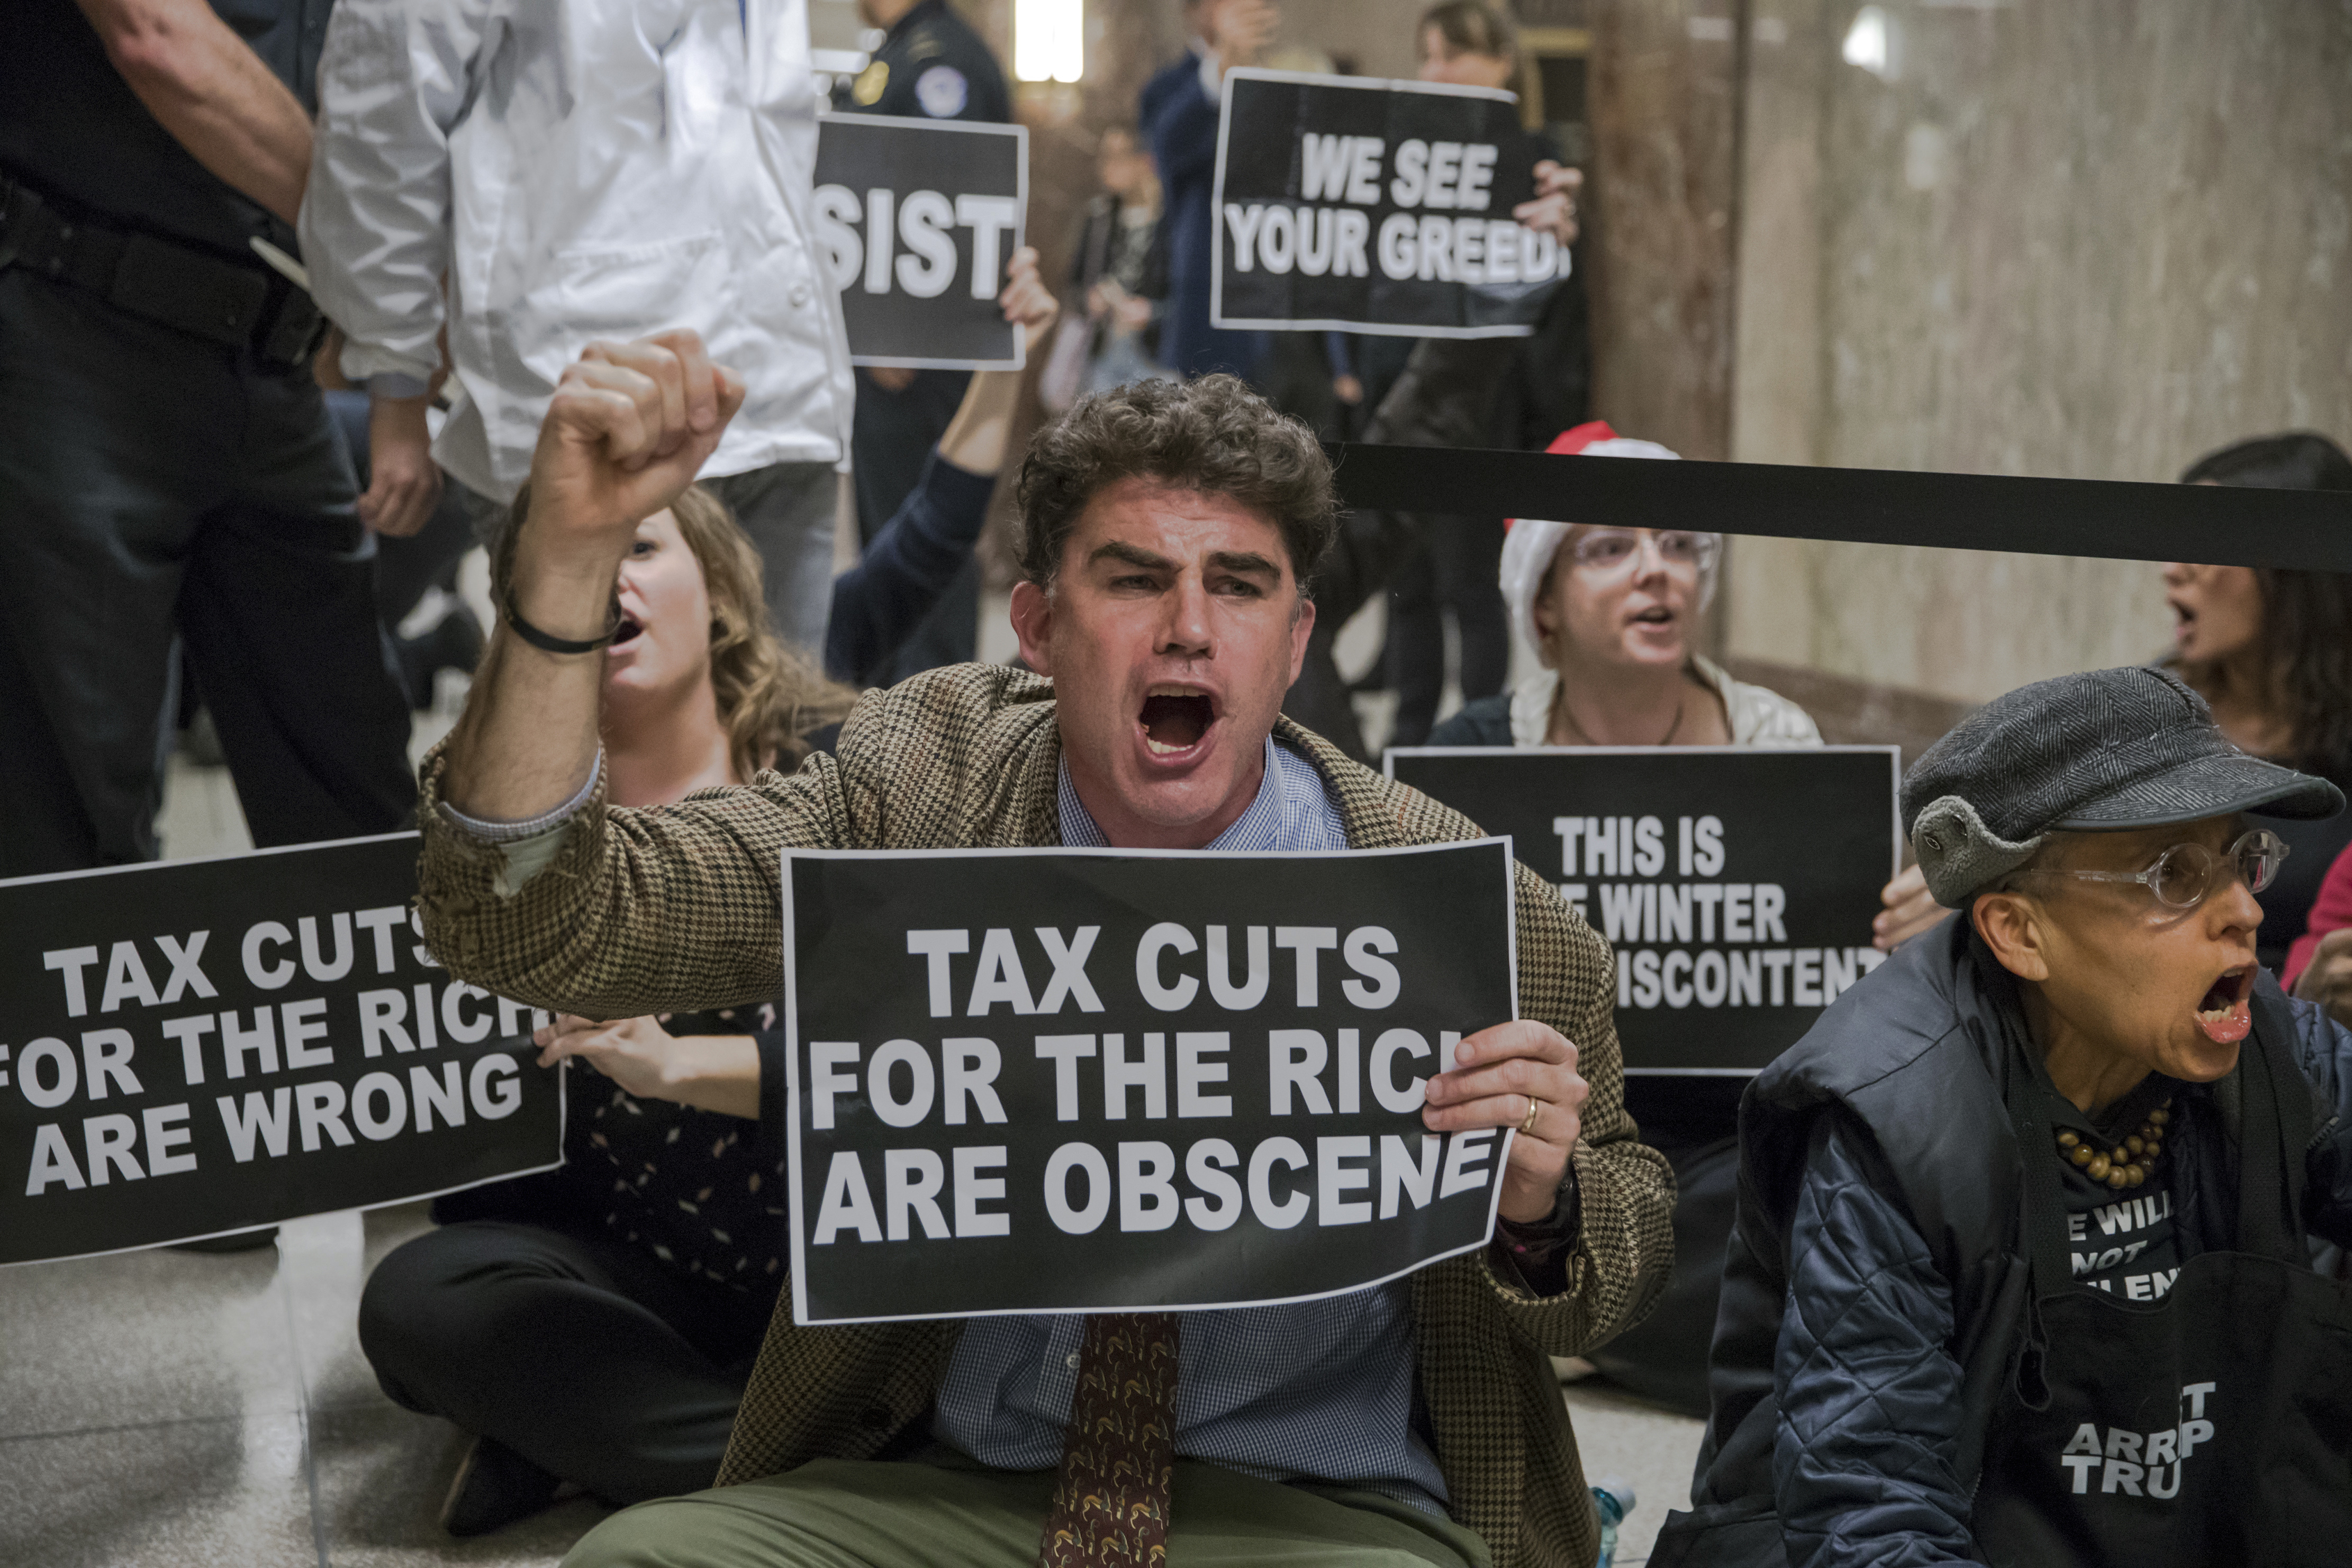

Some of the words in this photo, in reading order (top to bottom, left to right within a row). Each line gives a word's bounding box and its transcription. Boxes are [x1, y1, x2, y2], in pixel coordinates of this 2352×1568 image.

[1301, 132, 1386, 205] WE
[1390, 139, 1499, 211] SEE
[812, 183, 1017, 300] SIST
[1224, 203, 1370, 277] YOUR
[1377, 213, 1572, 285] GREED
[1553, 815, 1666, 877] THIS
[1678, 815, 1725, 877] IS
[1598, 883, 1787, 943] WINTER
[43, 930, 219, 1018] TAX
[907, 926, 1105, 1018] TAX
[1136, 922, 1401, 1011] CUTS
[161, 998, 334, 1085] THE
[810, 1037, 1008, 1130] FOR
[1035, 1031, 1233, 1121] THE
[25, 1102, 197, 1196] ARE
[215, 1053, 522, 1163] WRONG
[813, 1145, 1010, 1245] ARE
[1044, 1129, 1497, 1235] OBSCENE
[2070, 1240, 2148, 1276] NOT
